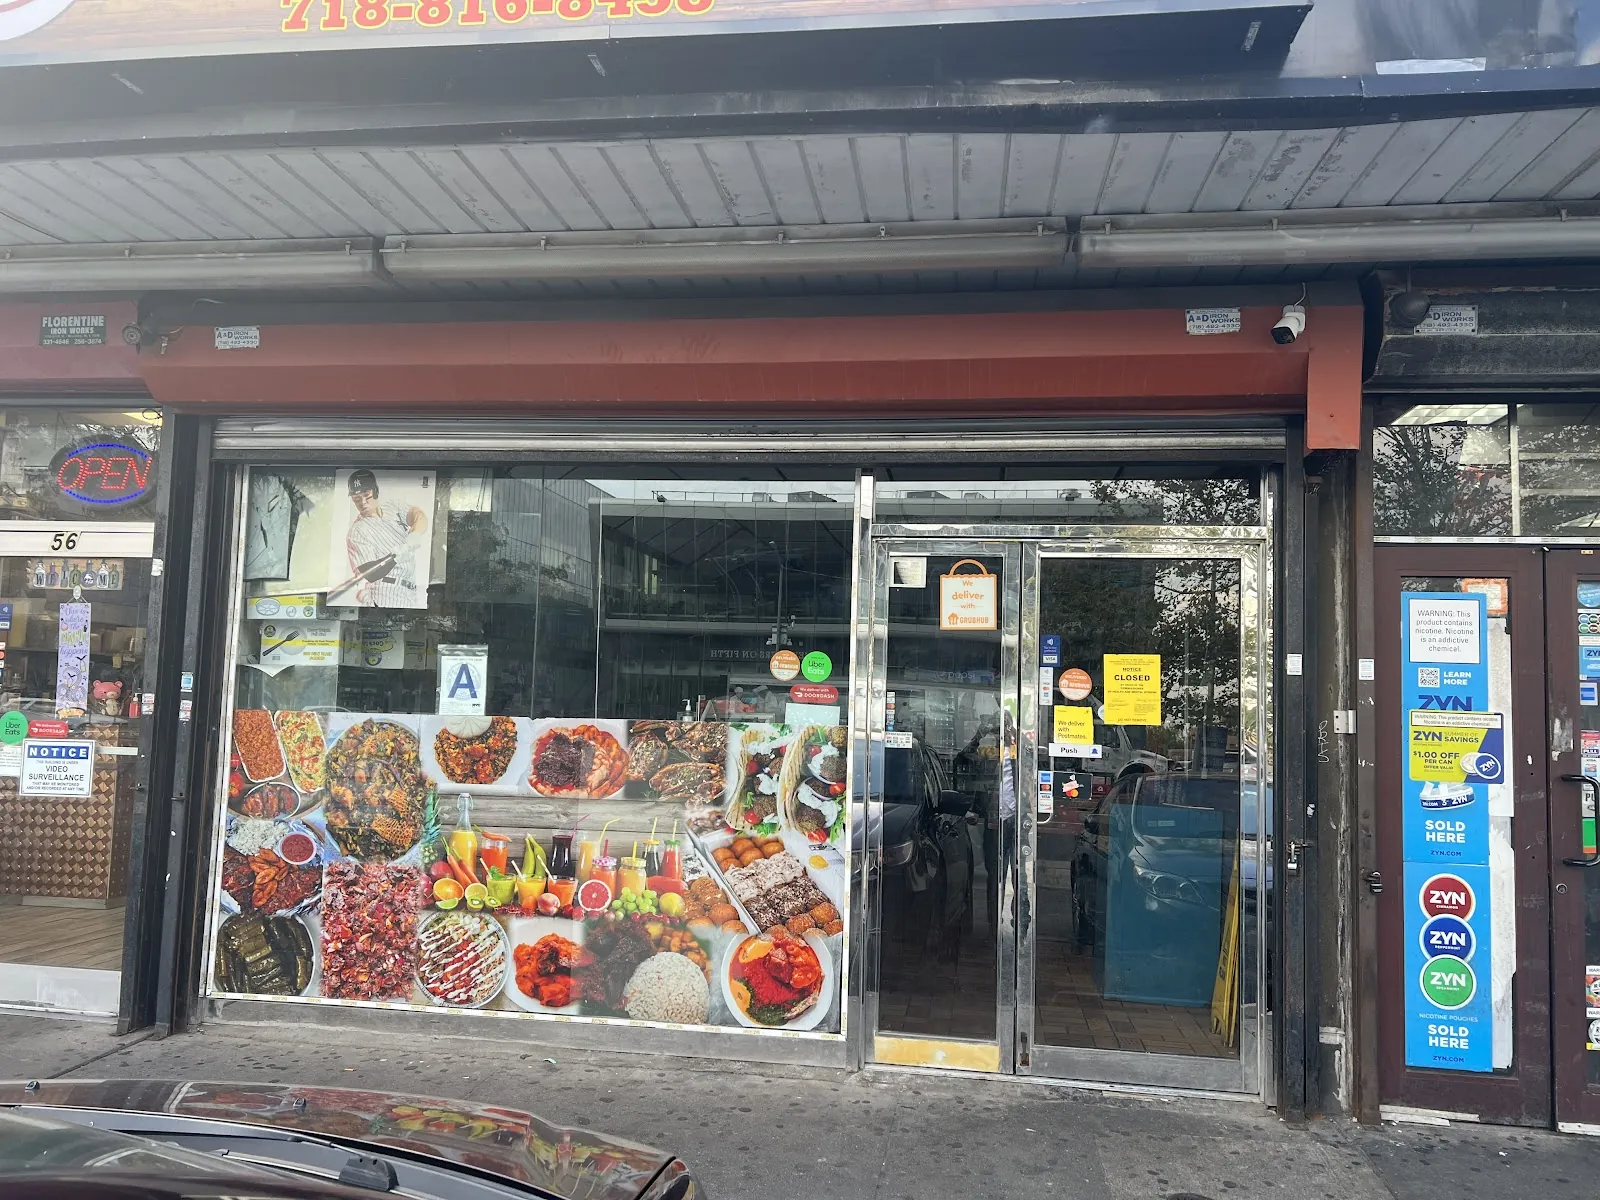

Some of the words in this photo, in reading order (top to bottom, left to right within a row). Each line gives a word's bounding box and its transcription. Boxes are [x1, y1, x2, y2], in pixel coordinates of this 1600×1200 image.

[42, 316, 104, 327] FLORENTINE
[50, 327, 67, 335] IRON
[69, 326, 95, 335] WORKS
[57, 457, 153, 490] OPEN
[51, 533, 78, 551] 56
[952, 590, 985, 600] deliver
[960, 616, 989, 624] GRUBHUB
[808, 660, 825, 668] Uber
[807, 666, 825, 675] Eats
[1443, 671, 1472, 679] LEARN
[448, 663, 478, 699] A
[1114, 674, 1151, 682] CLOSED
[1443, 678, 1468, 686] MORE
[1418, 694, 1472, 711] ZYN
[5, 722, 21, 730] Uber
[5, 728, 20, 736] Eats
[1413, 731, 1443, 742] ZYN
[29, 747, 88, 758] NOTICE
[1413, 749, 1437, 759] $1.00
[1440, 751, 1460, 759] OFF
[45, 765, 68, 773] VIDEO
[1479, 759, 1496, 773] ZYN
[28, 773, 85, 781] SURVEILLANCE
[1453, 795, 1470, 805] ZYN
[1425, 819, 1466, 832] SOLD
[1425, 831, 1466, 844] HERE
[1430, 849, 1462, 857] ZYN.COM
[1429, 889, 1466, 906] ZYN
[1429, 930, 1466, 946] ZYN
[1430, 971, 1466, 987] ZYN
[1418, 1012, 1448, 1021] NICOTINE
[1449, 1014, 1479, 1023] POUCHES
[1427, 1024, 1469, 1038] SOLD
[1428, 1036, 1469, 1050] HERE
[1432, 1055, 1465, 1064] ZYN.COM
